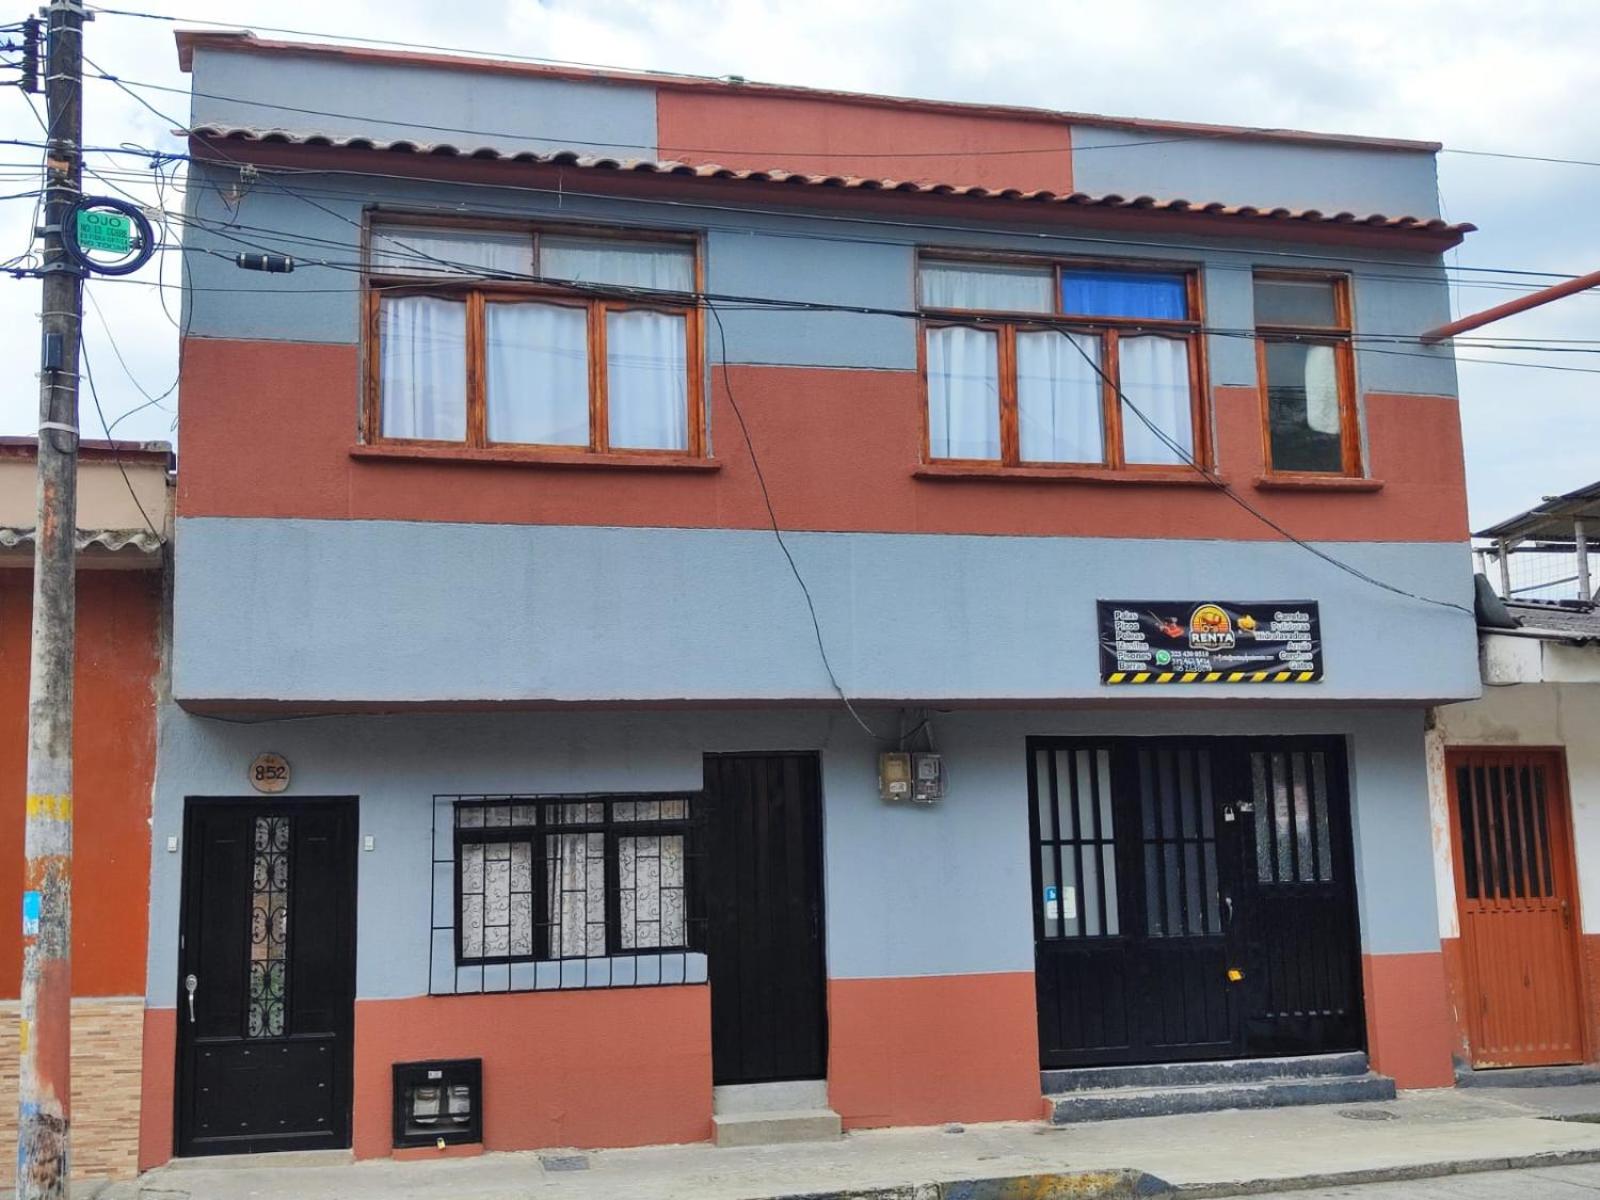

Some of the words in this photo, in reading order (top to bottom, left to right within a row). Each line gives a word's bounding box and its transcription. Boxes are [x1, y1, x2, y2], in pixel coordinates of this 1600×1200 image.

[87, 214, 121, 227] OJO
[1114, 610, 1138, 621] Palas
[1115, 621, 1140, 631] Picos
[1191, 633, 1233, 642] RENTA
[1117, 651, 1152, 661] Pisones
[255, 765, 287, 780] 852
